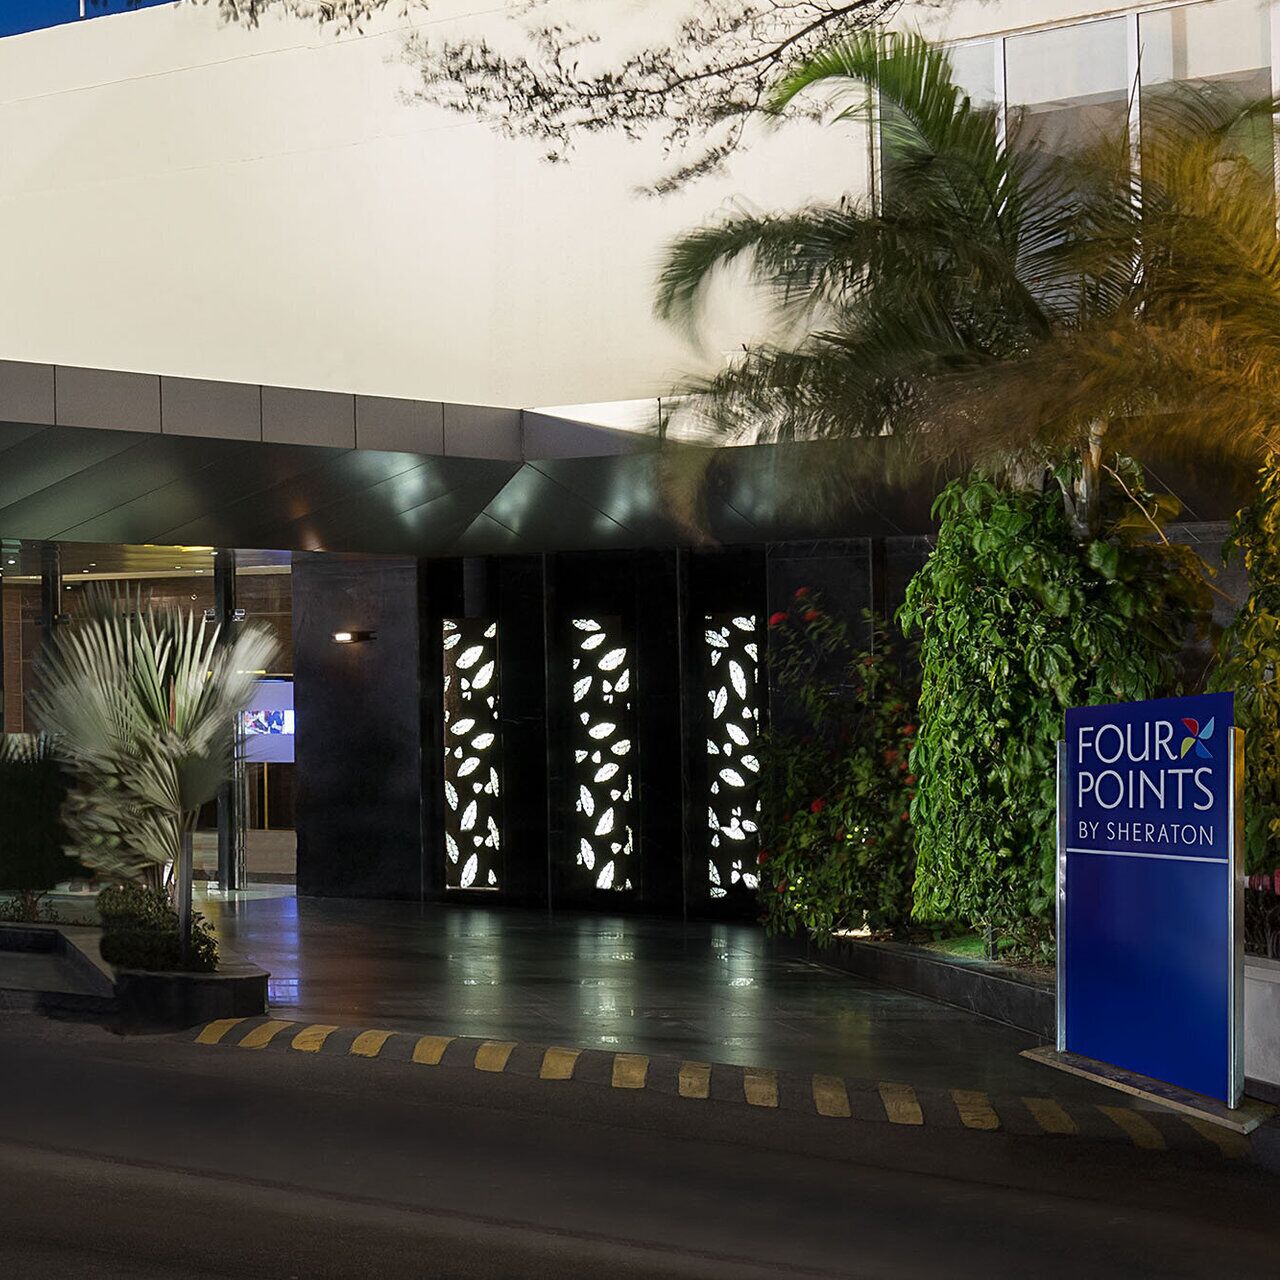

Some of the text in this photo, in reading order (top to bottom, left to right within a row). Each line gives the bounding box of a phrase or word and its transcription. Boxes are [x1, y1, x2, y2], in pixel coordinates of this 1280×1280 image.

[1078, 720, 1179, 764] FOUR
[1078, 767, 1214, 811] POINTS
[1078, 821, 1214, 846] BY SHERATON
